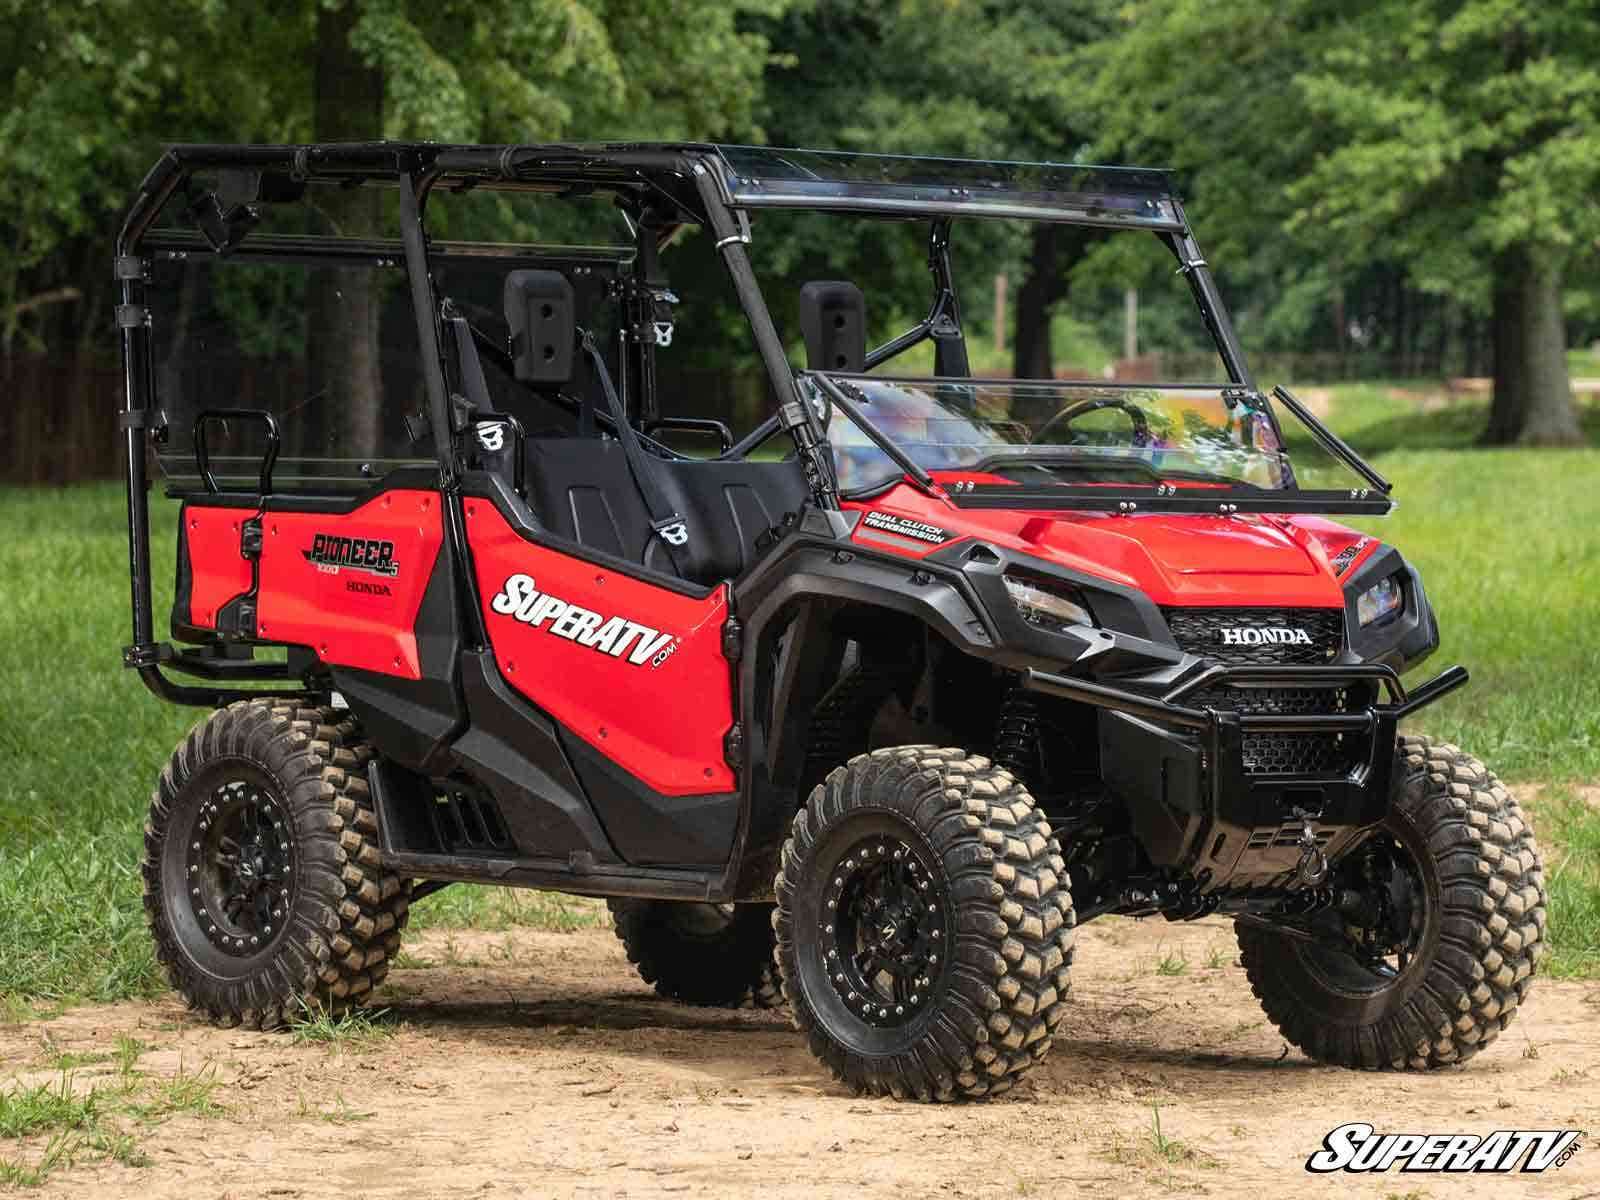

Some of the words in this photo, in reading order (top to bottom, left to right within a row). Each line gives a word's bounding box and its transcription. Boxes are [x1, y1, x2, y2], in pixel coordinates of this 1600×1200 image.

[864, 517, 945, 544] TRANSMISSION
[868, 511, 897, 524] DUAL
[900, 519, 943, 535] CLUTCH
[311, 533, 394, 569] PIONEER
[346, 581, 393, 597] HONDA
[1220, 628, 1313, 645] HONDA
